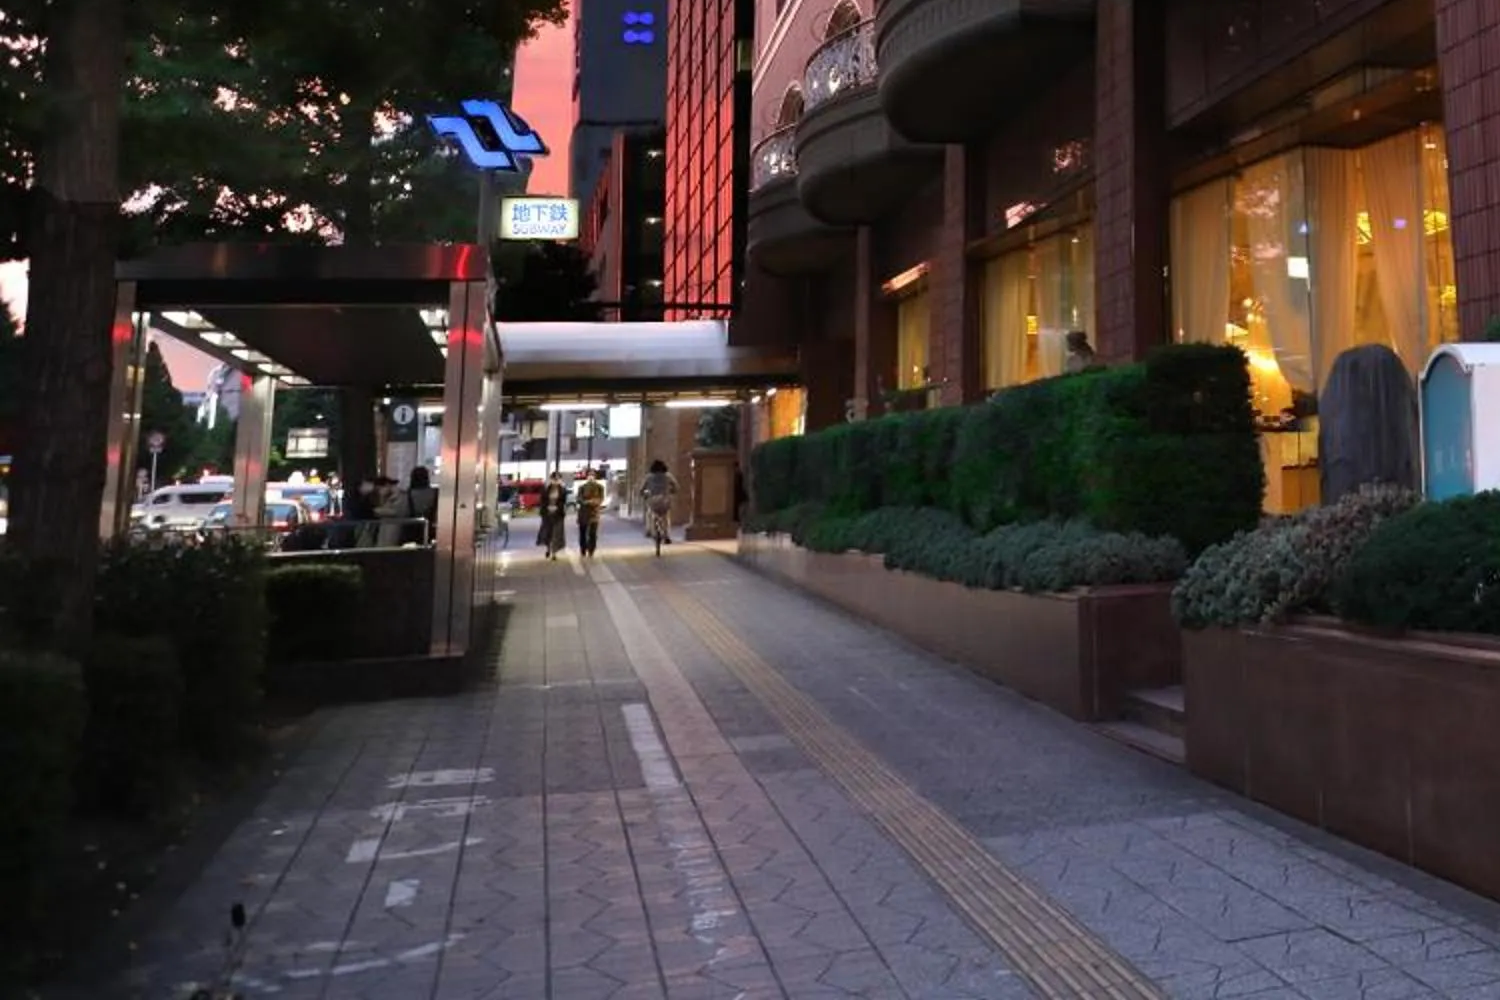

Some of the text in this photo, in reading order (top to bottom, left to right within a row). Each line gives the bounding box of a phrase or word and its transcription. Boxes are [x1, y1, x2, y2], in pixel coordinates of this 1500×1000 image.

[511, 203, 568, 222] 地下鉄
[511, 223, 567, 235] SUBWAY
